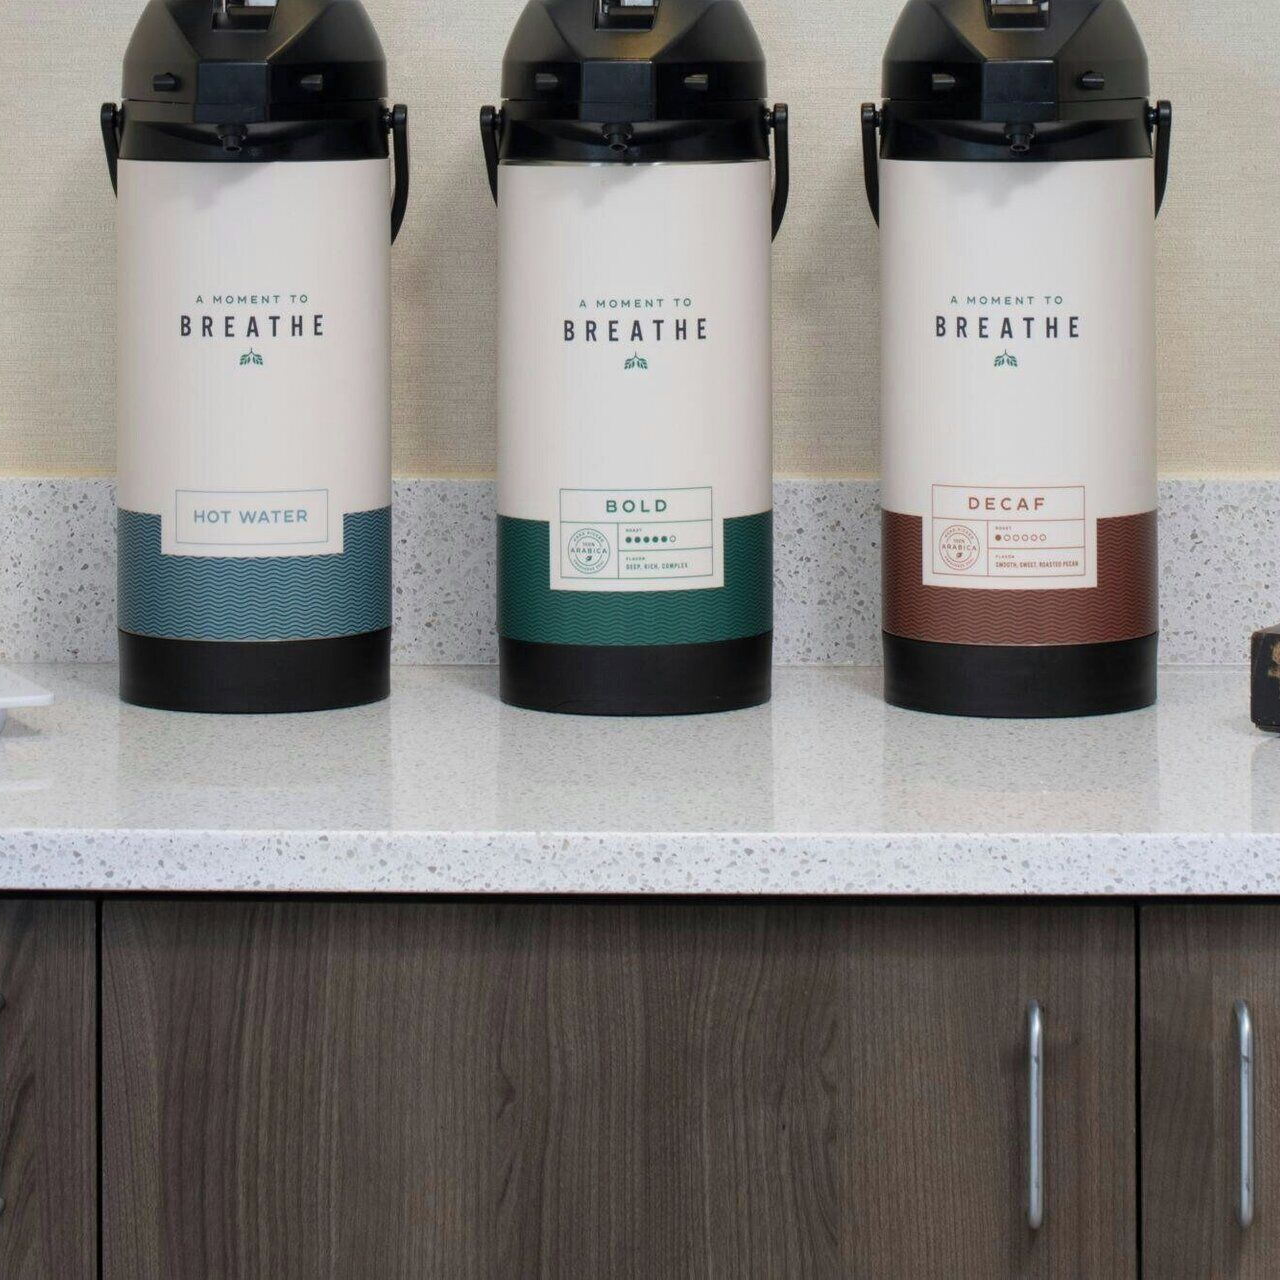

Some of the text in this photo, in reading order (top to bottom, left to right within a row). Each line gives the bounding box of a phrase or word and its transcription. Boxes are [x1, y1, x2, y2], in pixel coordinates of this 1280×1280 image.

[195, 294, 308, 304] A MOMENT TO
[579, 298, 692, 308] A MOMENT TO
[950, 295, 1063, 305] A MOMENT TO
[180, 314, 323, 337] BREATHE
[564, 318, 706, 341] BREATHE
[936, 316, 1079, 338] BREATHE
[606, 499, 667, 513] BOLD
[968, 497, 1045, 511] DECAF
[194, 509, 308, 524] HOT WATER
